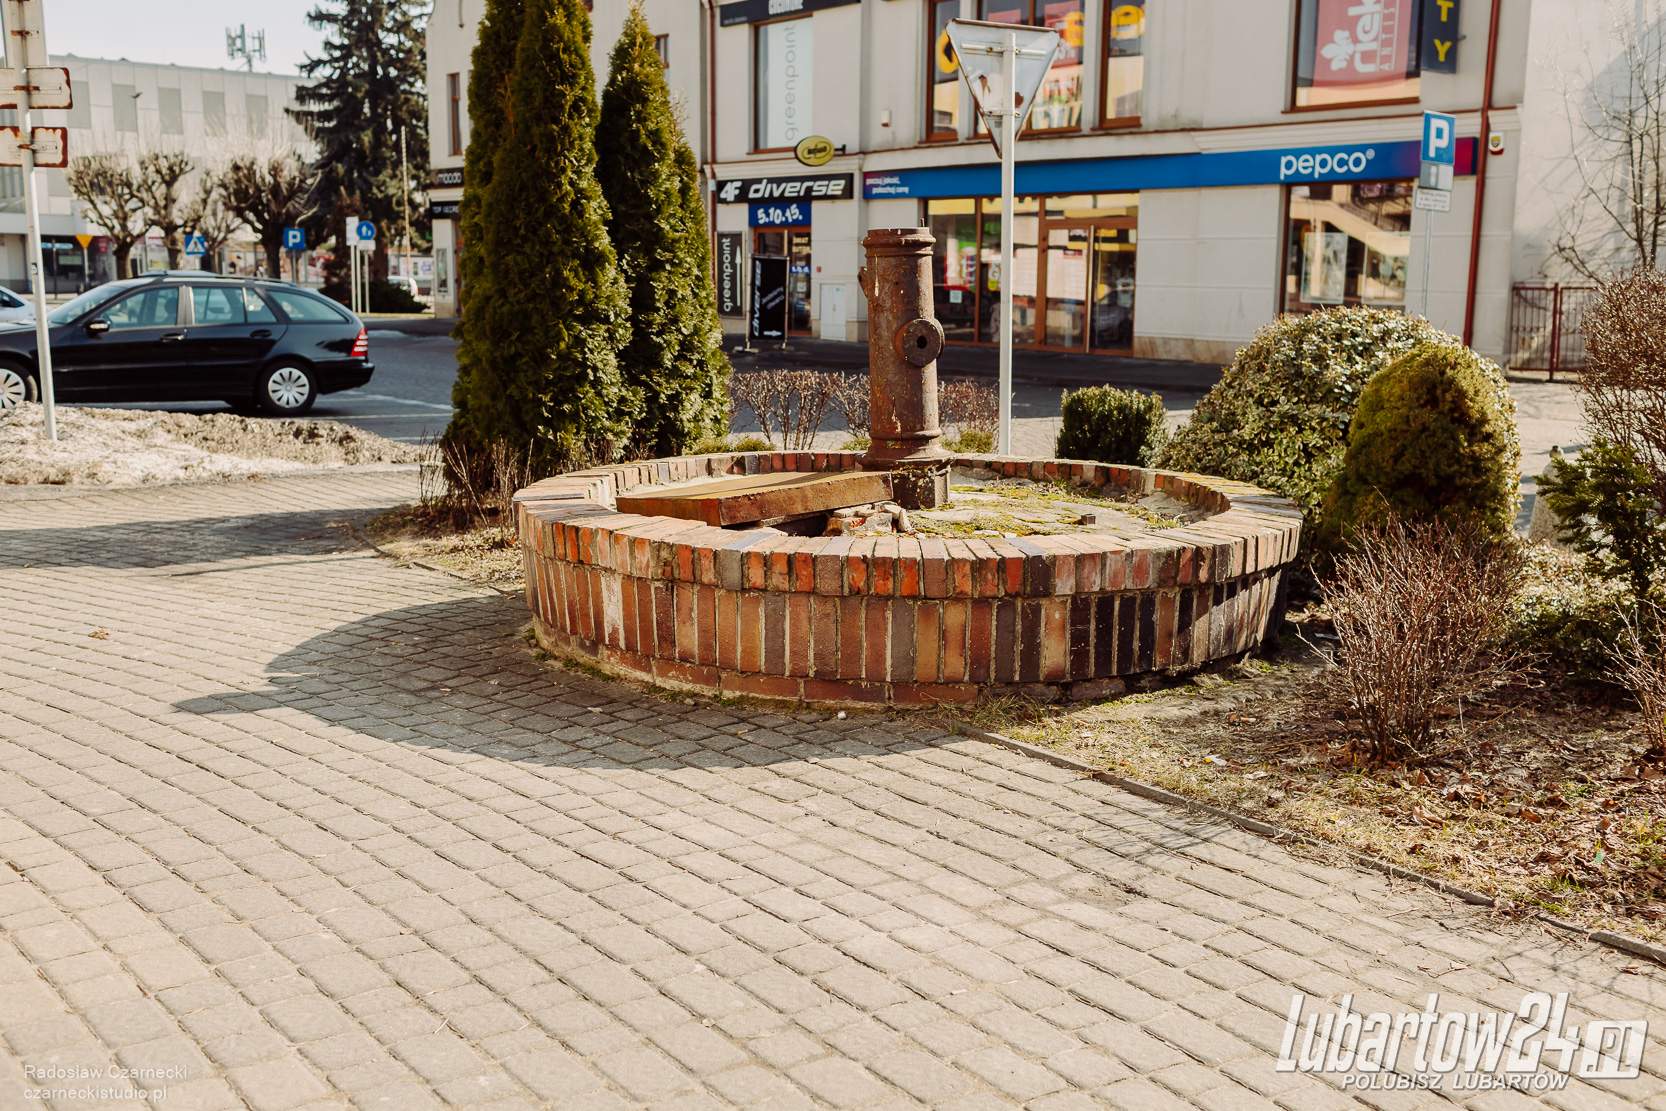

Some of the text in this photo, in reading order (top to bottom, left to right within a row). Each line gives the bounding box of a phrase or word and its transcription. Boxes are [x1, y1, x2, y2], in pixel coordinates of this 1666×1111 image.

[783, 23, 800, 142] greenpoint
[1428, 117, 1450, 158] P
[719, 180, 742, 202] 4F
[748, 178, 846, 199] diverse
[757, 203, 803, 224] 5.10.15.
[288, 230, 301, 247] P
[721, 237, 734, 312] greenpoint
